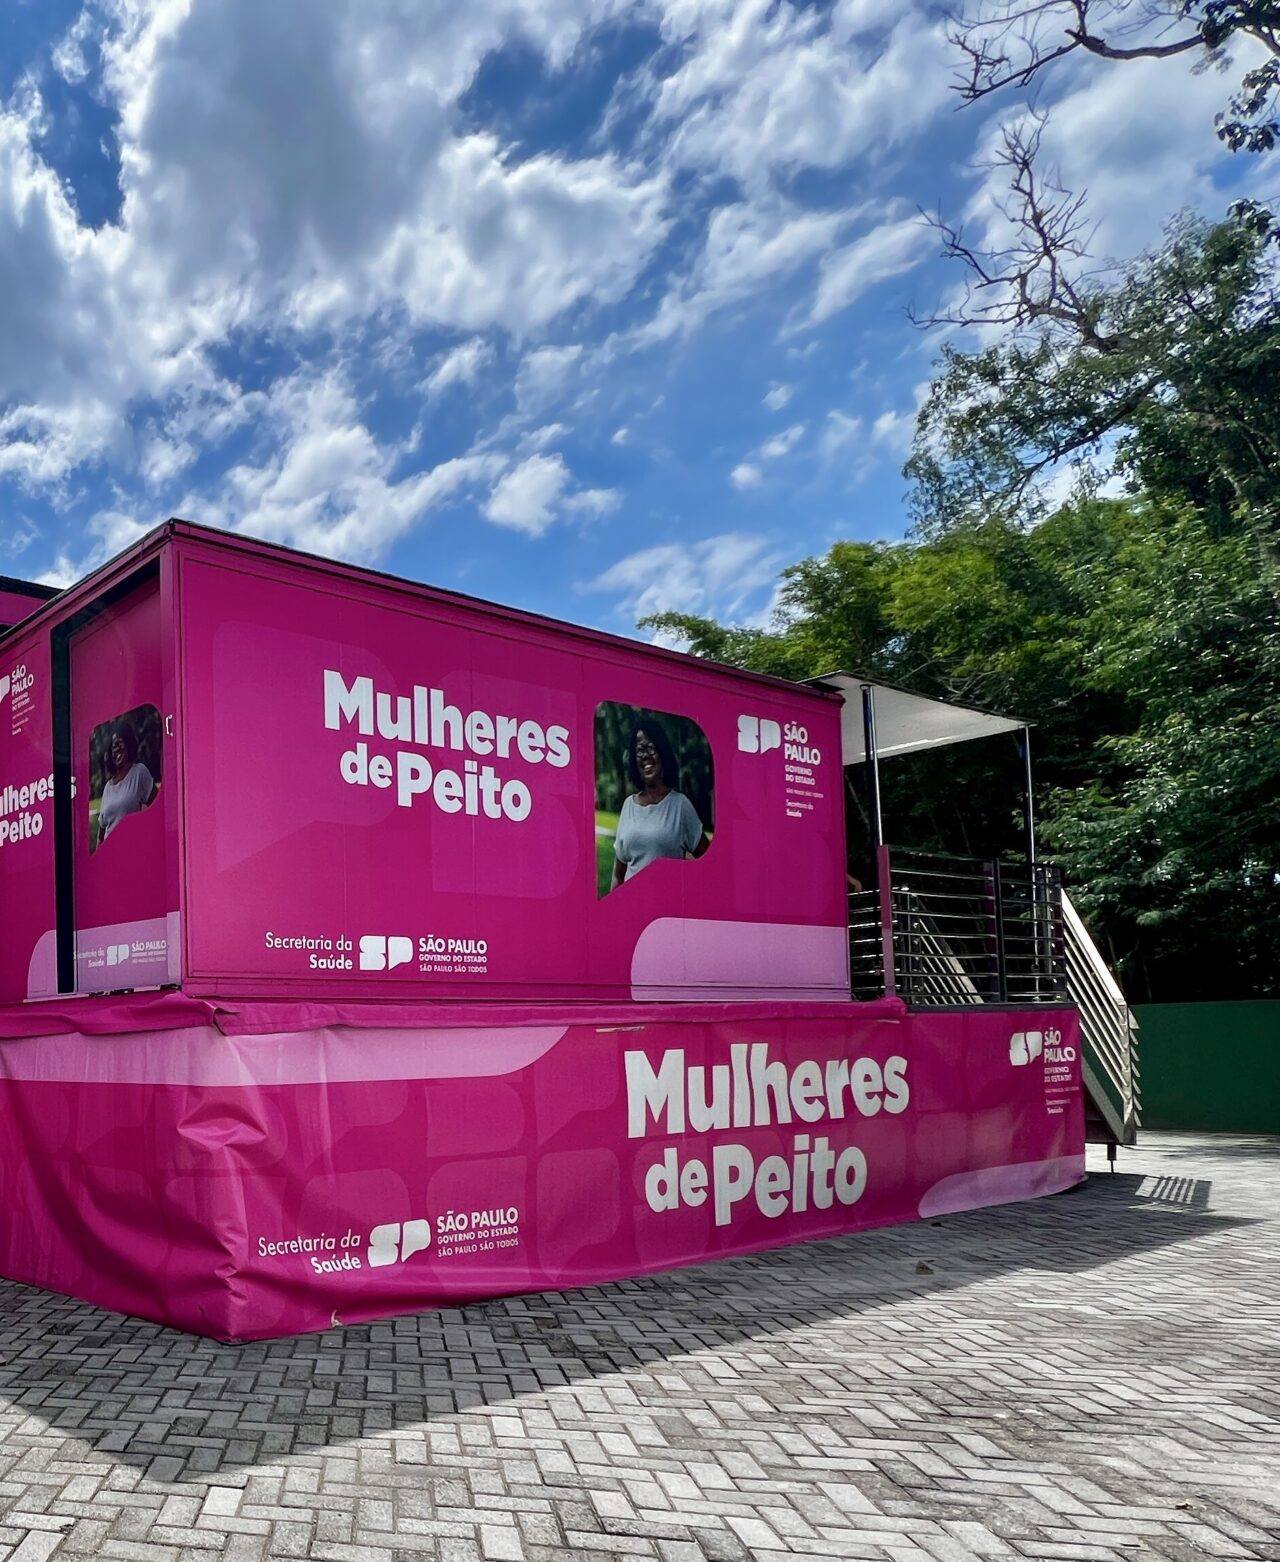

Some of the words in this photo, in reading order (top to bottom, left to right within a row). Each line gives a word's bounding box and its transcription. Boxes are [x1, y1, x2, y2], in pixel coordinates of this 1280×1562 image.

[12, 664, 26, 683] SÃO
[12, 673, 34, 697] PAULO
[322, 669, 571, 768] Mulheres
[784, 721, 808, 744] SÃO
[784, 743, 821, 766] PAULO
[131, 940, 145, 952] SÃO
[145, 939, 167, 950] PAULO
[265, 931, 332, 950] Secretaria
[336, 934, 353, 951] da
[419, 934, 446, 953] SÃO
[447, 938, 488, 954] PAULO
[309, 953, 353, 970] Saúde
[418, 953, 451, 962] GOVERNO
[463, 955, 488, 963] ESTADO
[419, 964, 433, 972] SÃO
[454, 964, 467, 972] SÃO
[1044, 1026, 1062, 1046] SÃO
[1043, 1046, 1076, 1063] PAULO
[624, 1042, 910, 1139] Mulheres
[437, 1210, 469, 1233] SÃO
[471, 1207, 519, 1229] PAULO
[258, 1232, 336, 1256] Secretaria
[340, 1228, 361, 1248] da
[437, 1232, 476, 1244] GOVERNO
[477, 1230, 490, 1239] DO
[491, 1226, 519, 1237] ESTADO
[438, 1247, 453, 1257] SÃO
[455, 1244, 478, 1254] PAULO
[480, 1241, 495, 1250] SÃO
[496, 1238, 519, 1248] TODOS
[310, 1251, 362, 1274] Saúde
